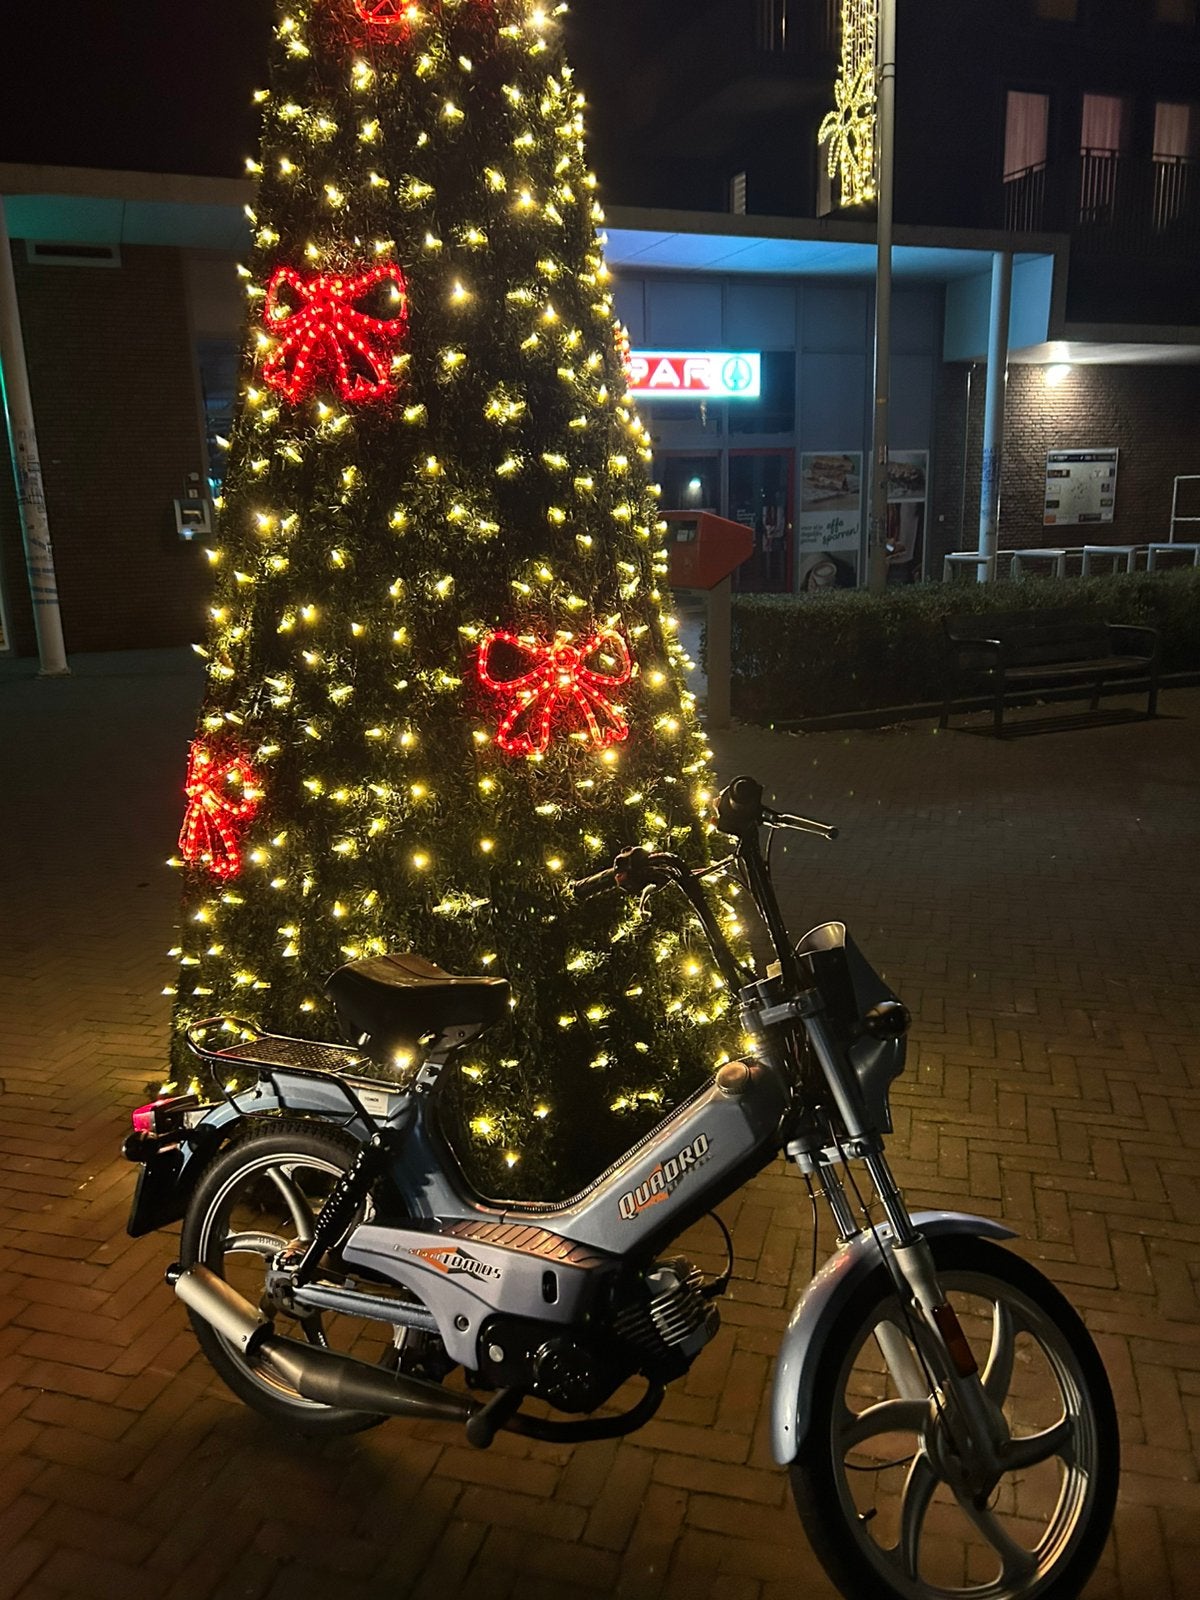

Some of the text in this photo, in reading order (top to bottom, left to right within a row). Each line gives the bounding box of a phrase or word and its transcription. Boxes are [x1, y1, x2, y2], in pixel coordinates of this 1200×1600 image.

[630, 357, 710, 388] PAR
[618, 1132, 710, 1220] QUADRO
[442, 1252, 503, 1280] TOMOS
